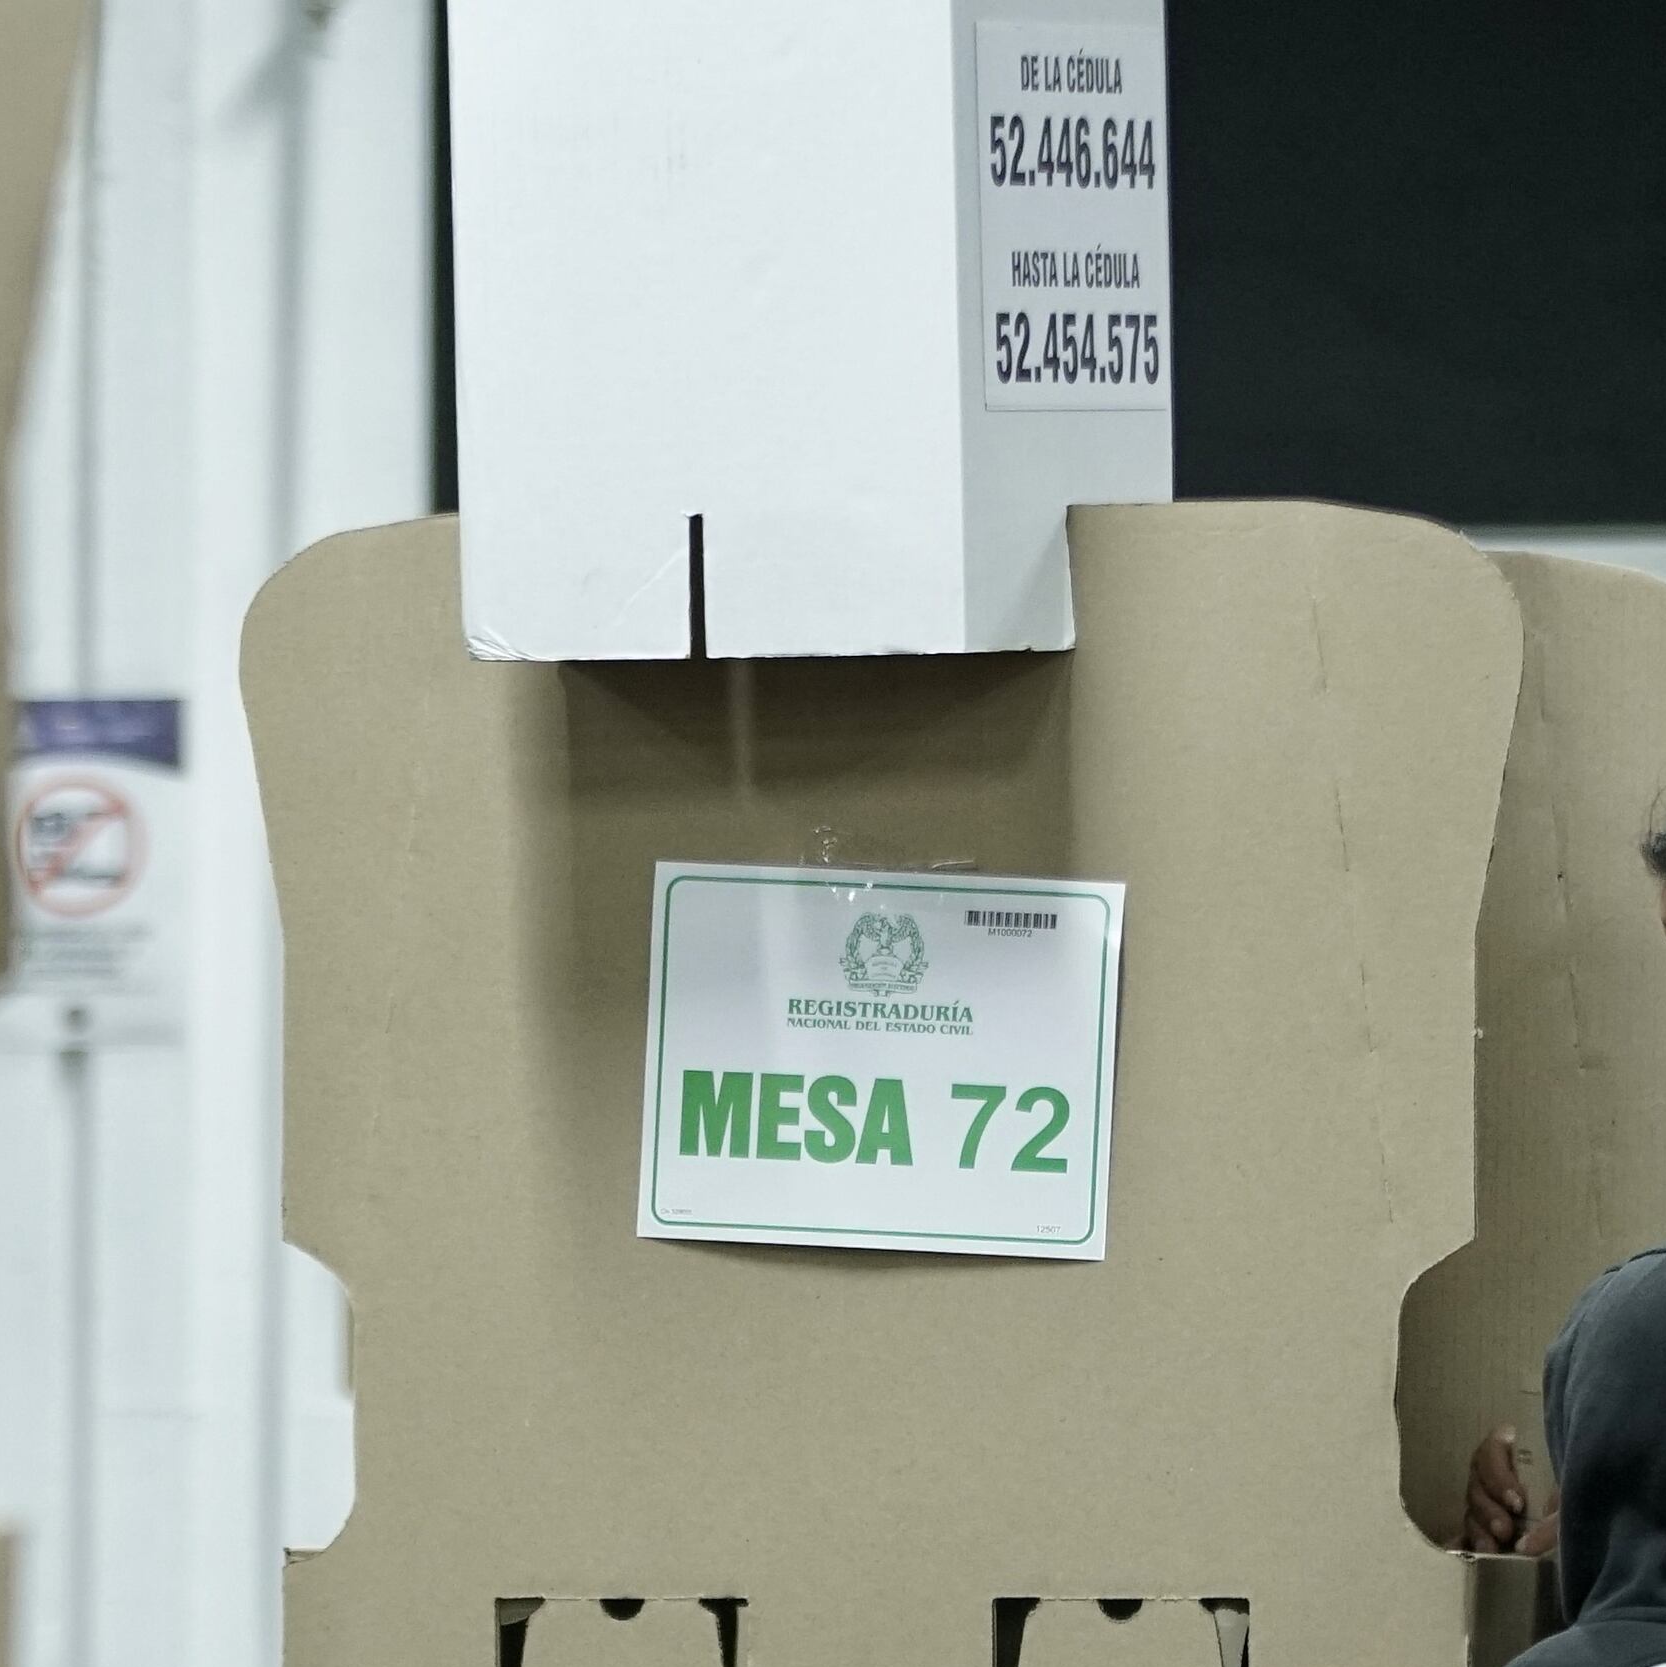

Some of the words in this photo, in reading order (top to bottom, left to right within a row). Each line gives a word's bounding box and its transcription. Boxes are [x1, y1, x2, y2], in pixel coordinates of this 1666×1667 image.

[1020, 55, 1040, 92] DE
[1044, 56, 1062, 92] LA
[1066, 48, 1123, 94] CÉDULA
[989, 113, 1156, 190] 52.446.644
[1011, 250, 1059, 288] HASTA
[1063, 251, 1081, 288] LA
[1084, 244, 1140, 290] CÉDULA
[995, 311, 1160, 386] 52.454.575
[786, 1017, 851, 1031] NACIONAL
[856, 1020, 880, 1032] DEL
[885, 1021, 937, 1034] ESTADO
[941, 1023, 973, 1036] CIVIL
[787, 997, 974, 1024] REGISTRADURÍA
[679, 1069, 913, 1167] MESA
[951, 1083, 1071, 1174] 72
